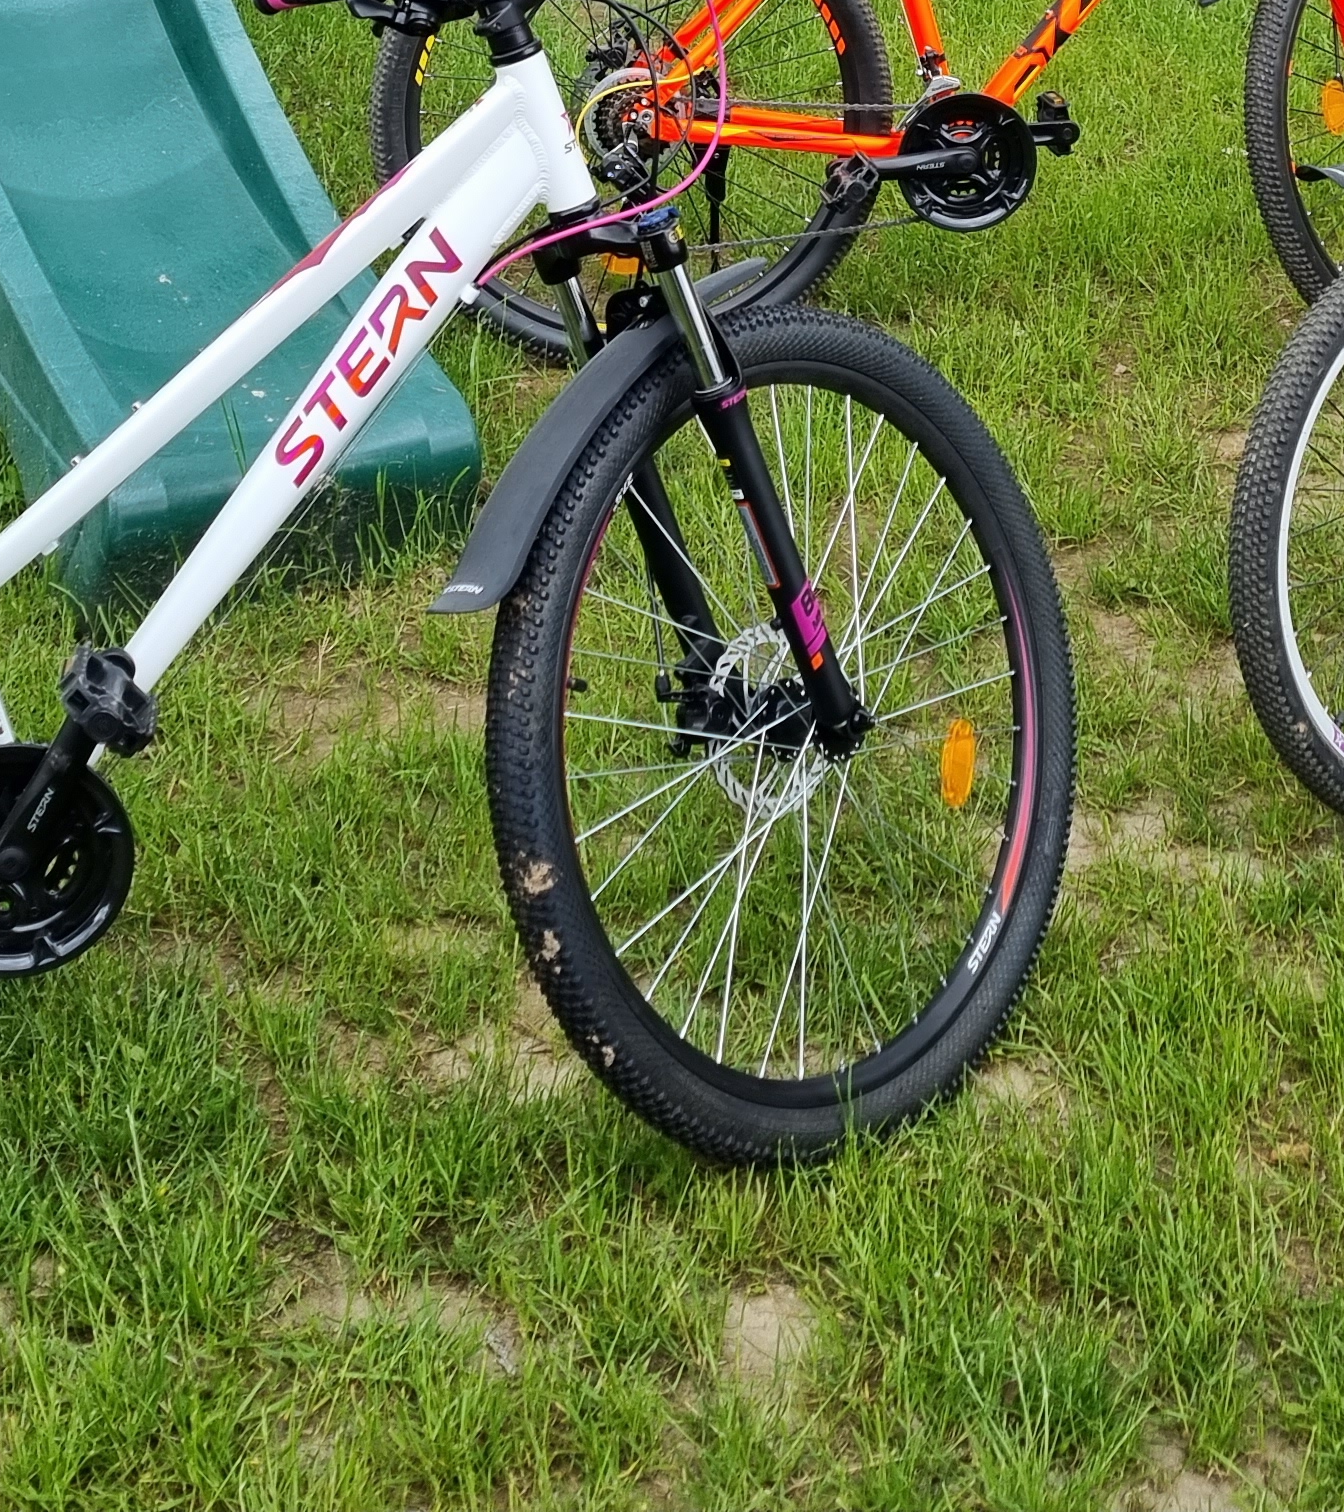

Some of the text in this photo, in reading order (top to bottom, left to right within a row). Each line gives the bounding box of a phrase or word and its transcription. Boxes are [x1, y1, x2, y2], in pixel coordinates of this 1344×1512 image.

[915, 161, 946, 171] STERN
[275, 227, 464, 489] STERN
[27, 787, 55, 833] STERN
[967, 910, 1001, 975] STERN
